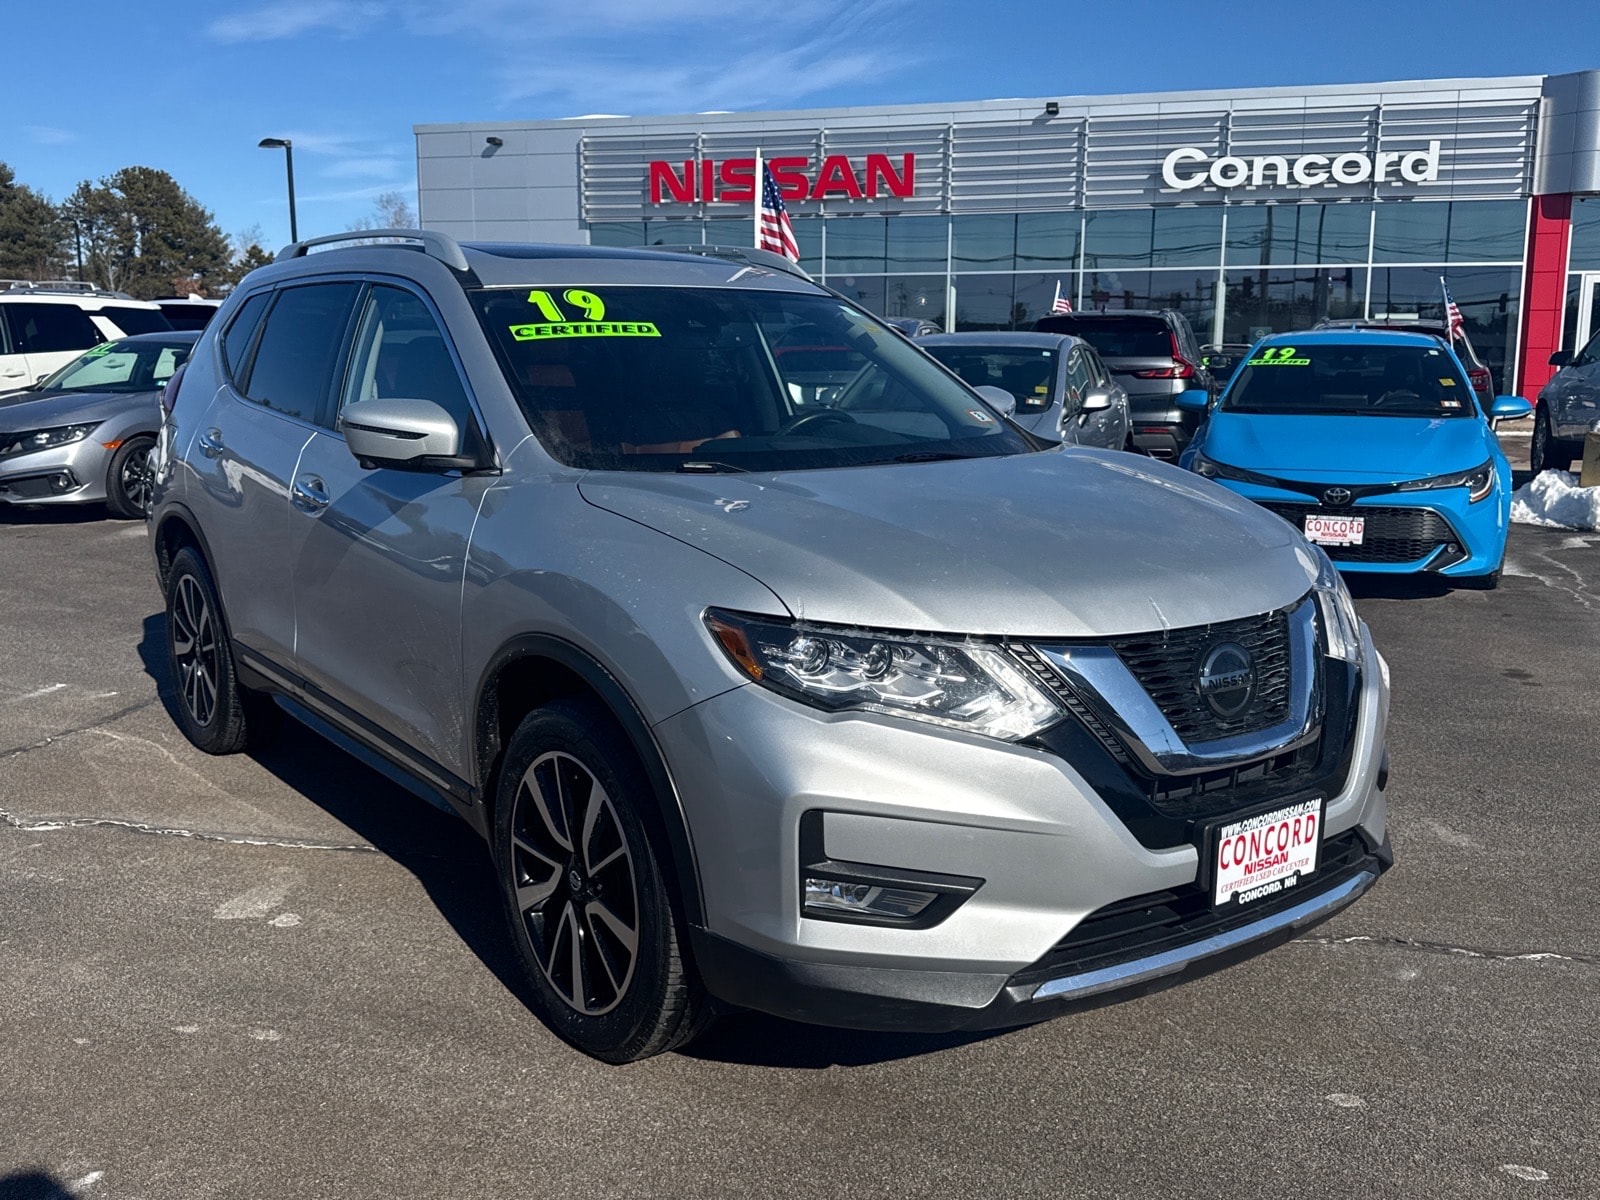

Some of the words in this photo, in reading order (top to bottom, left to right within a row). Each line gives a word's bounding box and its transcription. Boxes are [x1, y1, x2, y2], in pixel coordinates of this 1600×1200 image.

[650, 152, 915, 203] NISSAN
[1162, 140, 1441, 189] Concord
[527, 289, 605, 322] 19
[512, 323, 658, 339] CERTIFIED
[1262, 347, 1297, 361] 19
[1306, 520, 1363, 534] CONCORD
[1208, 671, 1251, 689] NISSAN
[1219, 814, 1316, 870] CONCORD
[1220, 876, 1255, 893] CERTIFIED
[1254, 869, 1272, 882] USED
[1272, 865, 1286, 877] CAR
[1285, 857, 1310, 872] CENTER
[1243, 851, 1289, 877] NISSAN
[1284, 874, 1298, 889] NH
